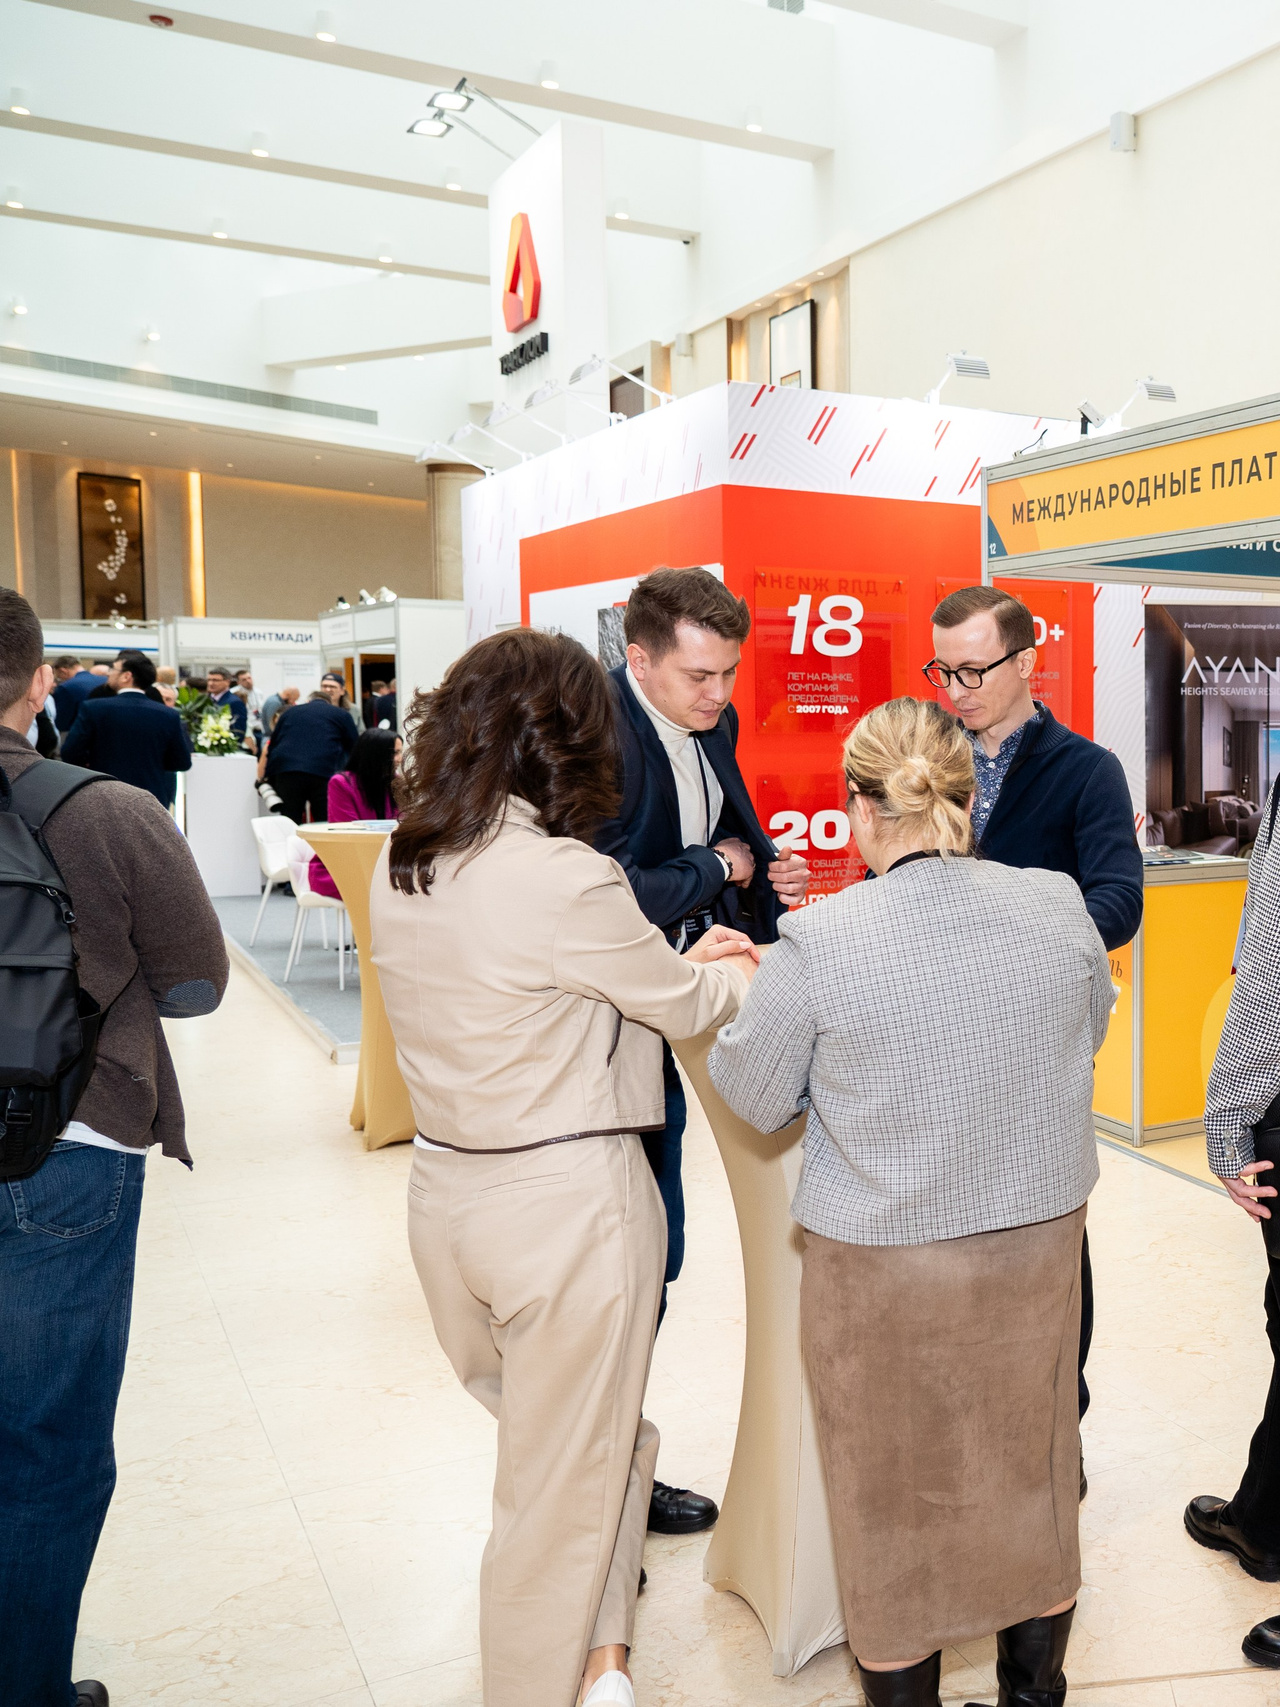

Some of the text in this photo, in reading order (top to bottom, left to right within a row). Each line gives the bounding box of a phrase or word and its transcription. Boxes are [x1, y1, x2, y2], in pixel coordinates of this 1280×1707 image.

[1012, 466, 1201, 525] МЕЖДУНАРОДНЫЕ
[989, 543, 997, 555] 12
[787, 594, 864, 657] 18
[230, 630, 314, 644] КВИНТМАДИ
[1181, 656, 1280, 683] AYAN
[787, 672, 854, 682] ЛЕТ НА РЫНКЕ,
[787, 683, 839, 692] КОМПАНИЯ
[1180, 687, 1218, 696] HEIGHTS
[1220, 687, 1257, 696] SEAVIEW
[787, 694, 860, 704] ПРЕДСТАВЛЕНА
[787, 705, 849, 715] С 2007 ГОДА
[812, 858, 850, 869] ОБЩЕГО
